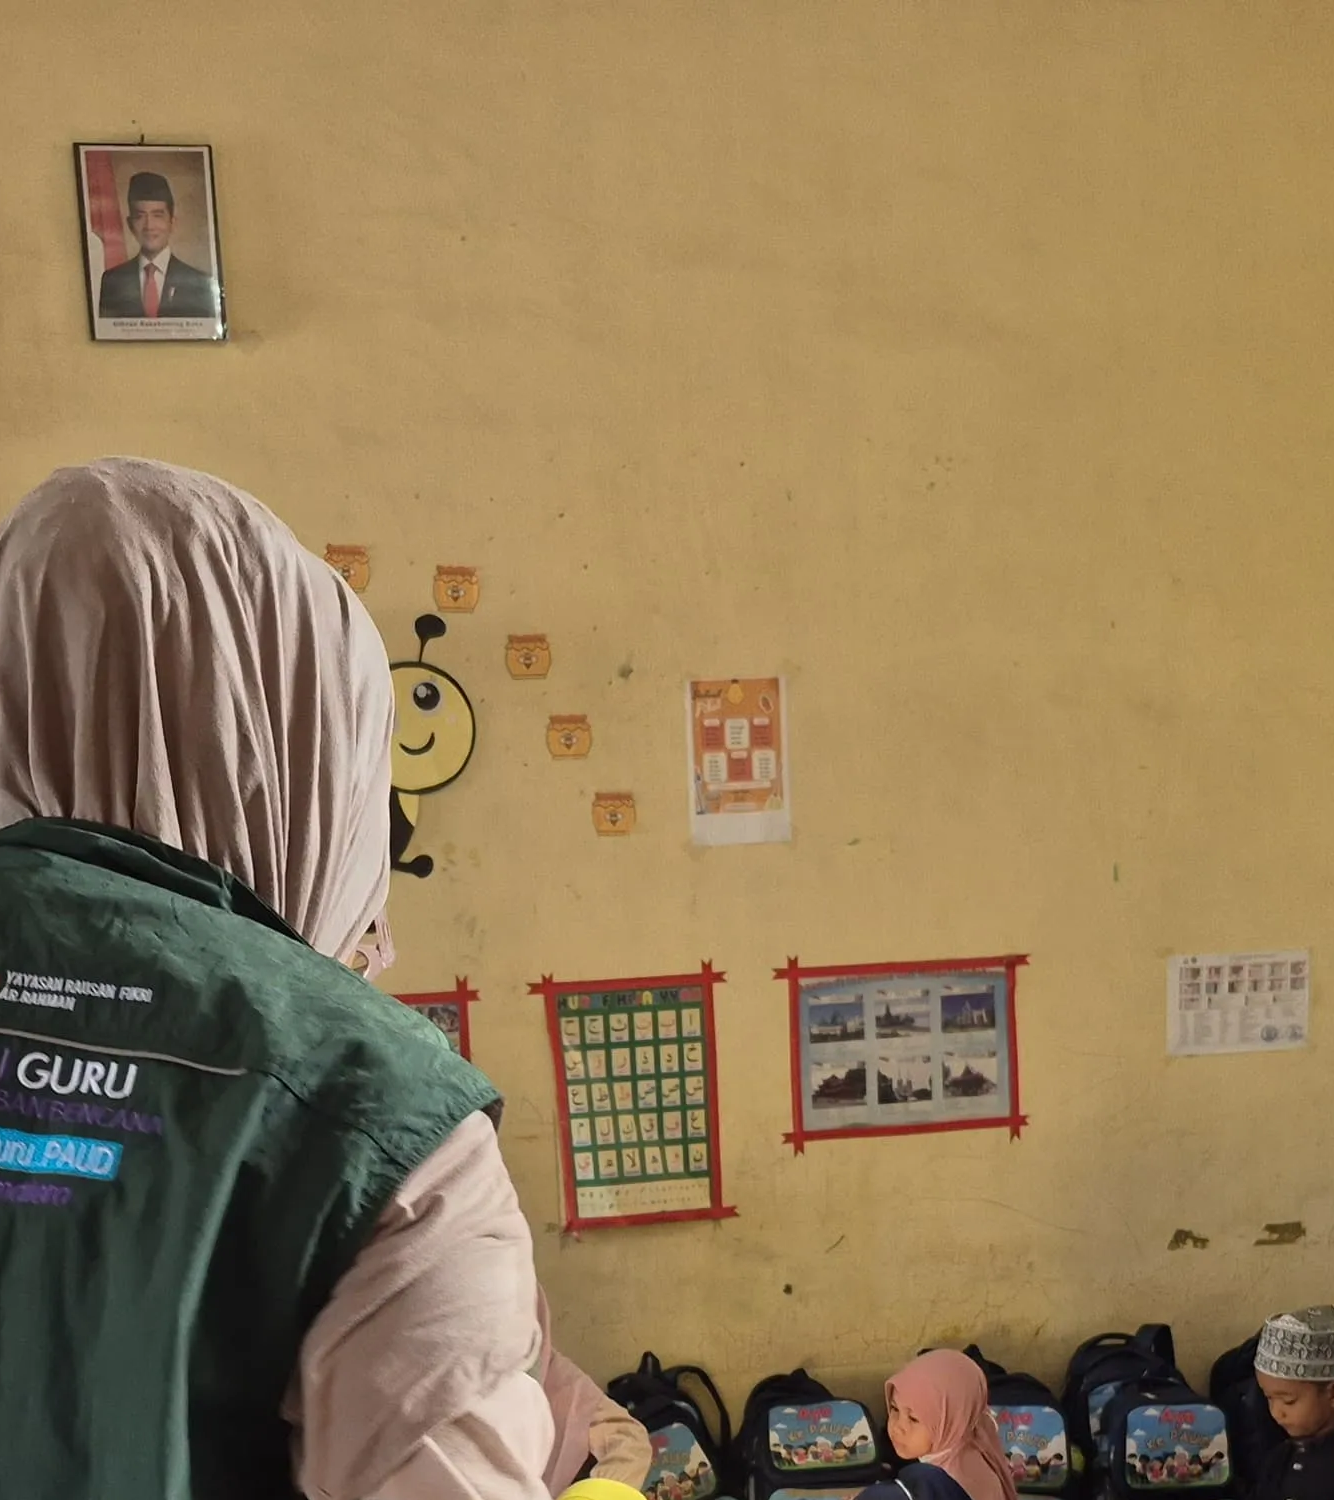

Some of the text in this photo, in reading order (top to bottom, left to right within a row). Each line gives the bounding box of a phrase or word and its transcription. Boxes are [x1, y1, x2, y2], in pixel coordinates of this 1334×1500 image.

[6, 970, 63, 992] YAYASAN
[16, 1051, 139, 1099] GURU
[38, 1140, 115, 1175] PAUD
